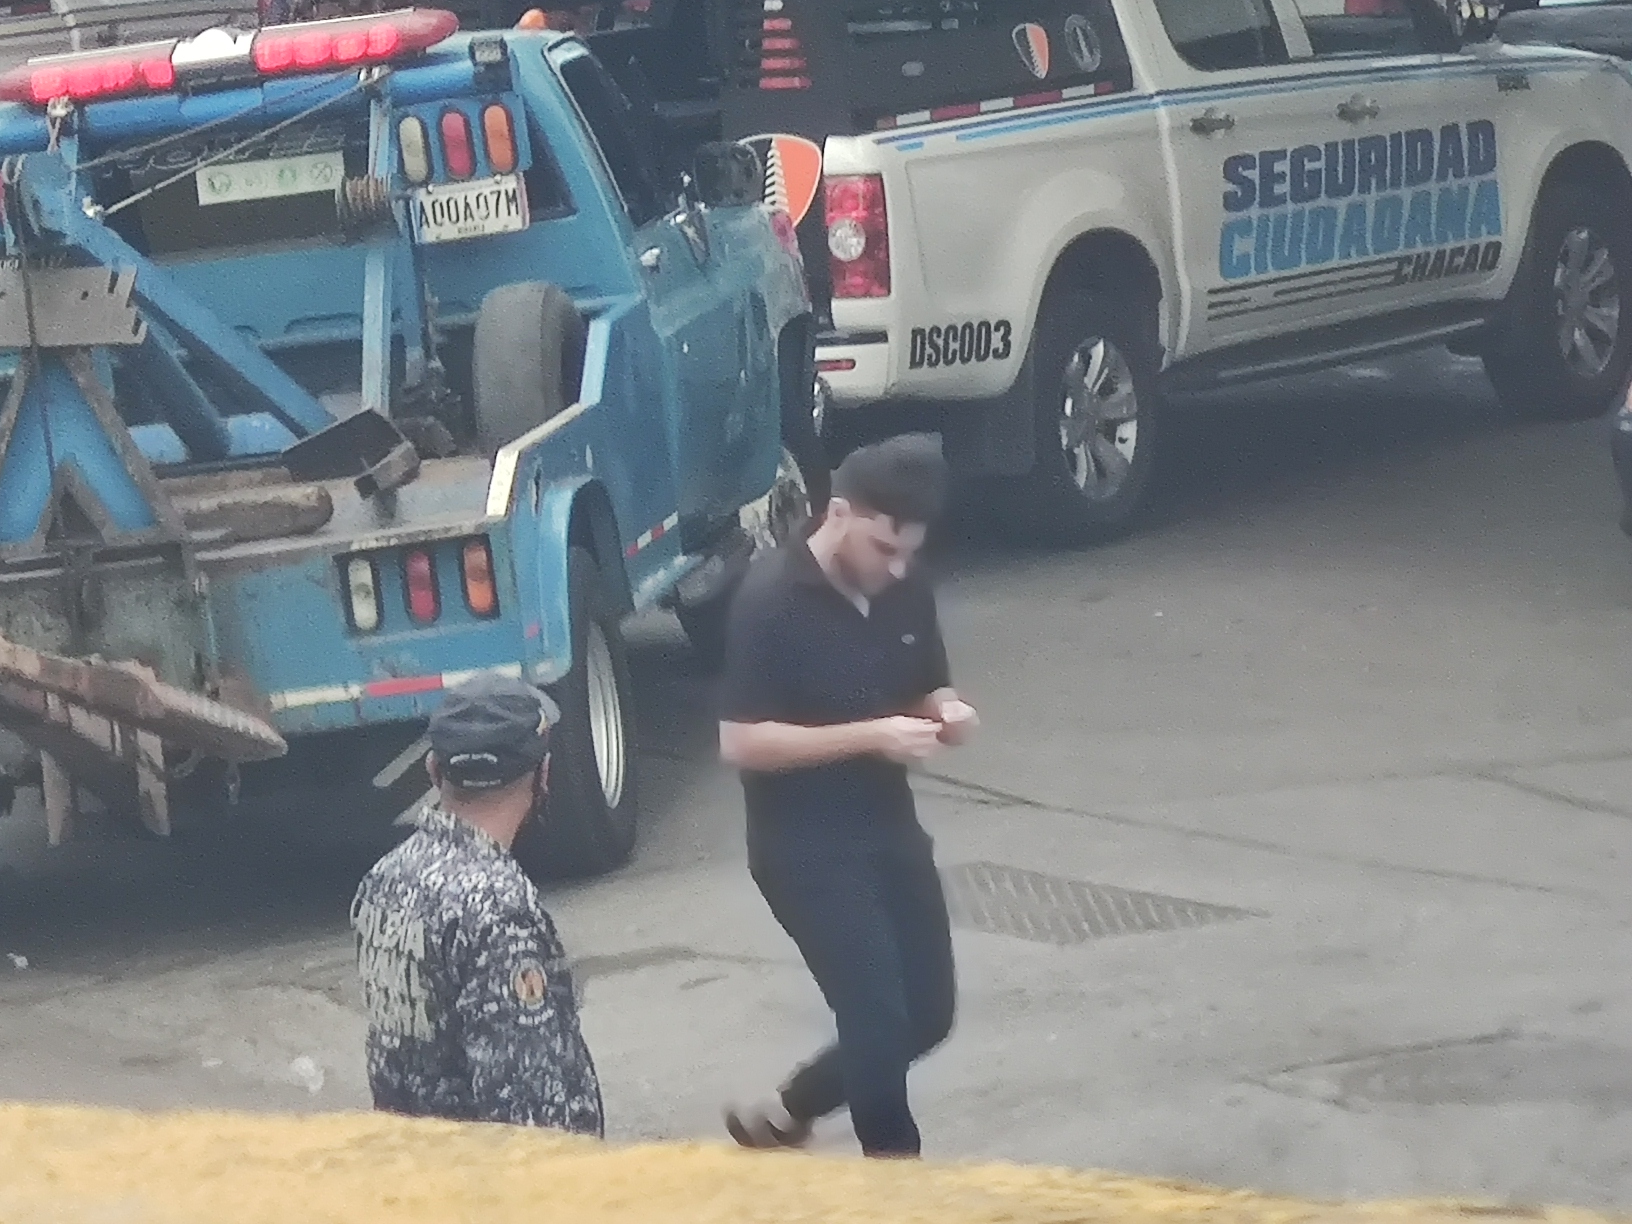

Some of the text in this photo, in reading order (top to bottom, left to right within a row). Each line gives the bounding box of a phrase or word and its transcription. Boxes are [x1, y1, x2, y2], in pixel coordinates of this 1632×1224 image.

[1222, 119, 1498, 213] SEGURIDAD
[1220, 178, 1502, 282] CIUDADANA
[1394, 240, 1503, 284] CHACAO
[908, 319, 1012, 370] DSC003
